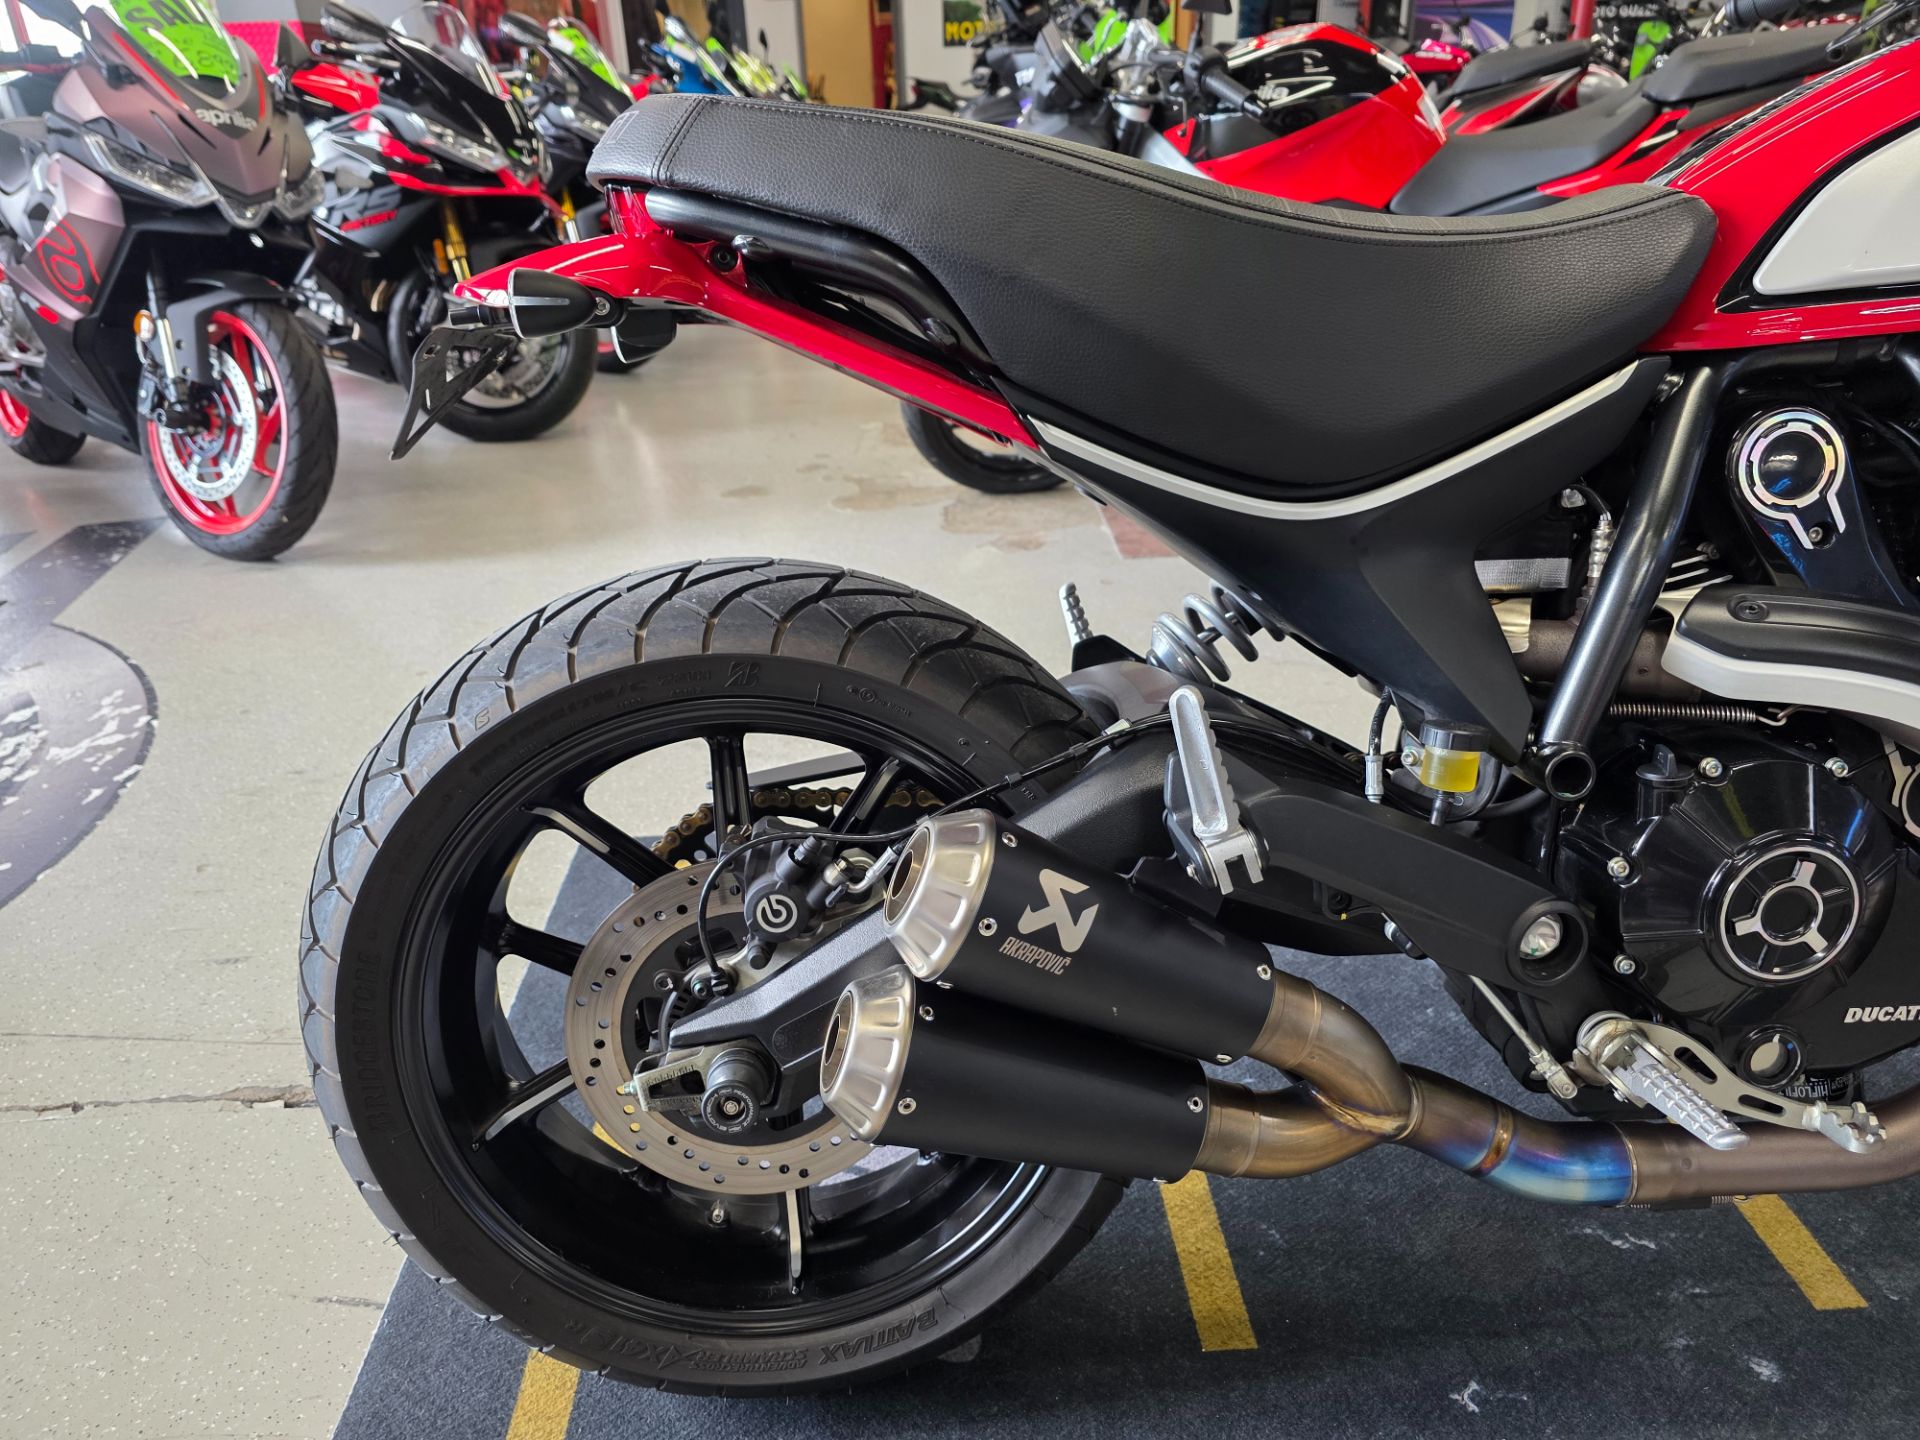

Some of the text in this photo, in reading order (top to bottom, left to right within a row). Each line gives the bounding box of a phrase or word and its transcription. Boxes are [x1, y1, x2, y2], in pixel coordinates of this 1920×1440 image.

[195, 108, 257, 131] aprilia
[1844, 1005, 1920, 1023] DUCAT
[818, 1306, 938, 1366] BATTLAX
